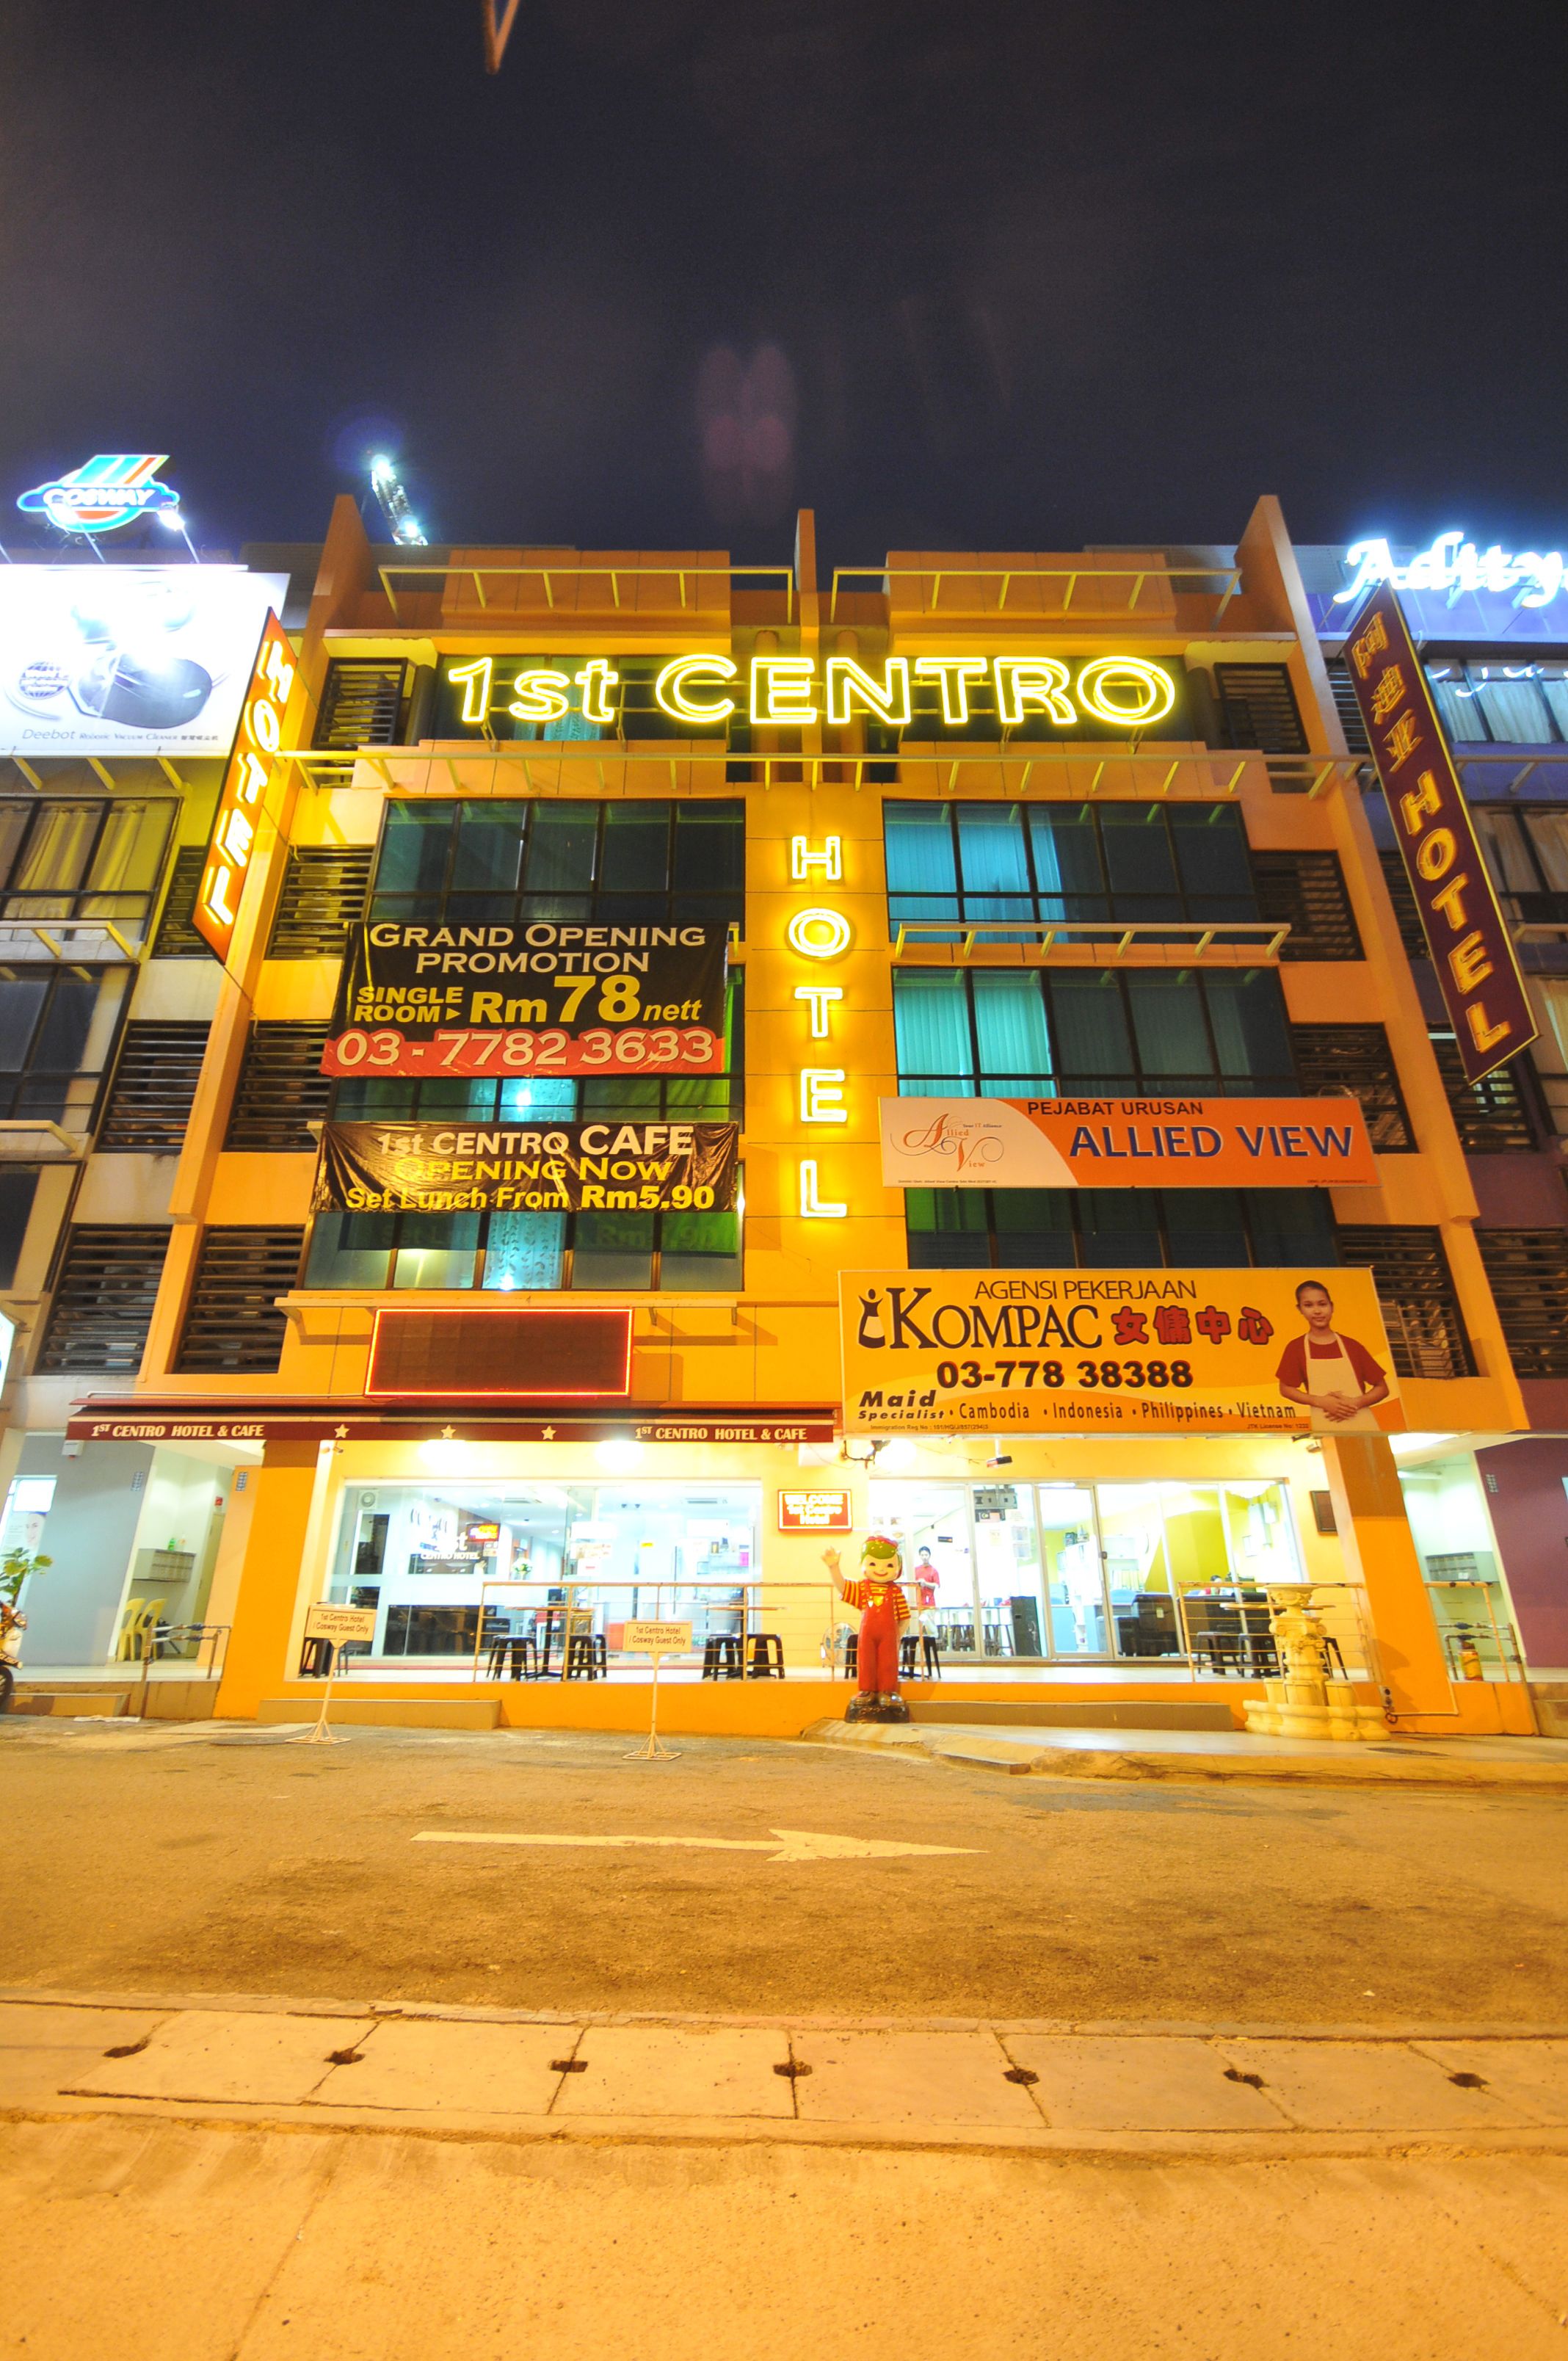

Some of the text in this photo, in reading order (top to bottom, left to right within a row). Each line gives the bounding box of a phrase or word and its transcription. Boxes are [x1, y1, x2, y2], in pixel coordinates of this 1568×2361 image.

[43, 487, 156, 507] COSWAY
[1333, 531, 1568, 609] Adity
[448, 653, 1176, 725] 1st CENTRO
[22, 729, 76, 740] Deebot
[202, 640, 294, 927] HOTEL
[1399, 769, 1511, 1054] HOTEL
[369, 923, 706, 947] GRAND OPENING
[415, 952, 649, 973] PROMOTION
[357, 987, 464, 1004] SINGLE
[470, 974, 703, 1023] Rm 78 nett
[355, 1005, 440, 1023] ROOM
[788, 835, 852, 1218] HOTEL
[438, 1031, 567, 1066] 7782
[579, 1030, 714, 1064] 3633
[1028, 1101, 1203, 1116] PEJABAT URUSAN
[378, 1125, 694, 1156] 1st CENTRO CAFE
[1069, 1125, 1354, 1157] ALLIED VIEW
[394, 1158, 567, 1181] OPENING
[346, 1185, 714, 1210] Set Lunch From Rm5.90
[975, 1280, 1197, 1300] AGENSI PEKERJAAN
[886, 1286, 1103, 1349] KOMPAC
[1111, 1305, 1274, 1346] 女傭中心
[937, 1360, 1194, 1389] 03-778 38388
[859, 1390, 937, 1408] Maid
[858, 1410, 945, 1421] Specialist
[959, 1401, 1296, 1423] Cambodia Indonesia Philippines Vietnam
[112, 1425, 166, 1437] CENTRO
[172, 1424, 215, 1437] HOTEL
[217, 1425, 228, 1437] &
[231, 1424, 265, 1437] CAFE
[656, 1427, 708, 1440] CENTRO
[714, 1428, 758, 1440] HOTEL
[761, 1429, 771, 1440] &
[774, 1427, 807, 1440] CAFE
[316, 1622, 338, 1632] Cosway
[338, 1623, 355, 1632] Guest
[356, 1625, 369, 1634] Only
[329, 1613, 349, 1622] Centro
[349, 1615, 365, 1623] Hotel
[632, 1636, 654, 1645] Cosway
[655, 1636, 672, 1644] Guest
[672, 1636, 686, 1646] Only
[645, 1626, 664, 1634] Centro
[665, 1627, 681, 1635] Hotel
